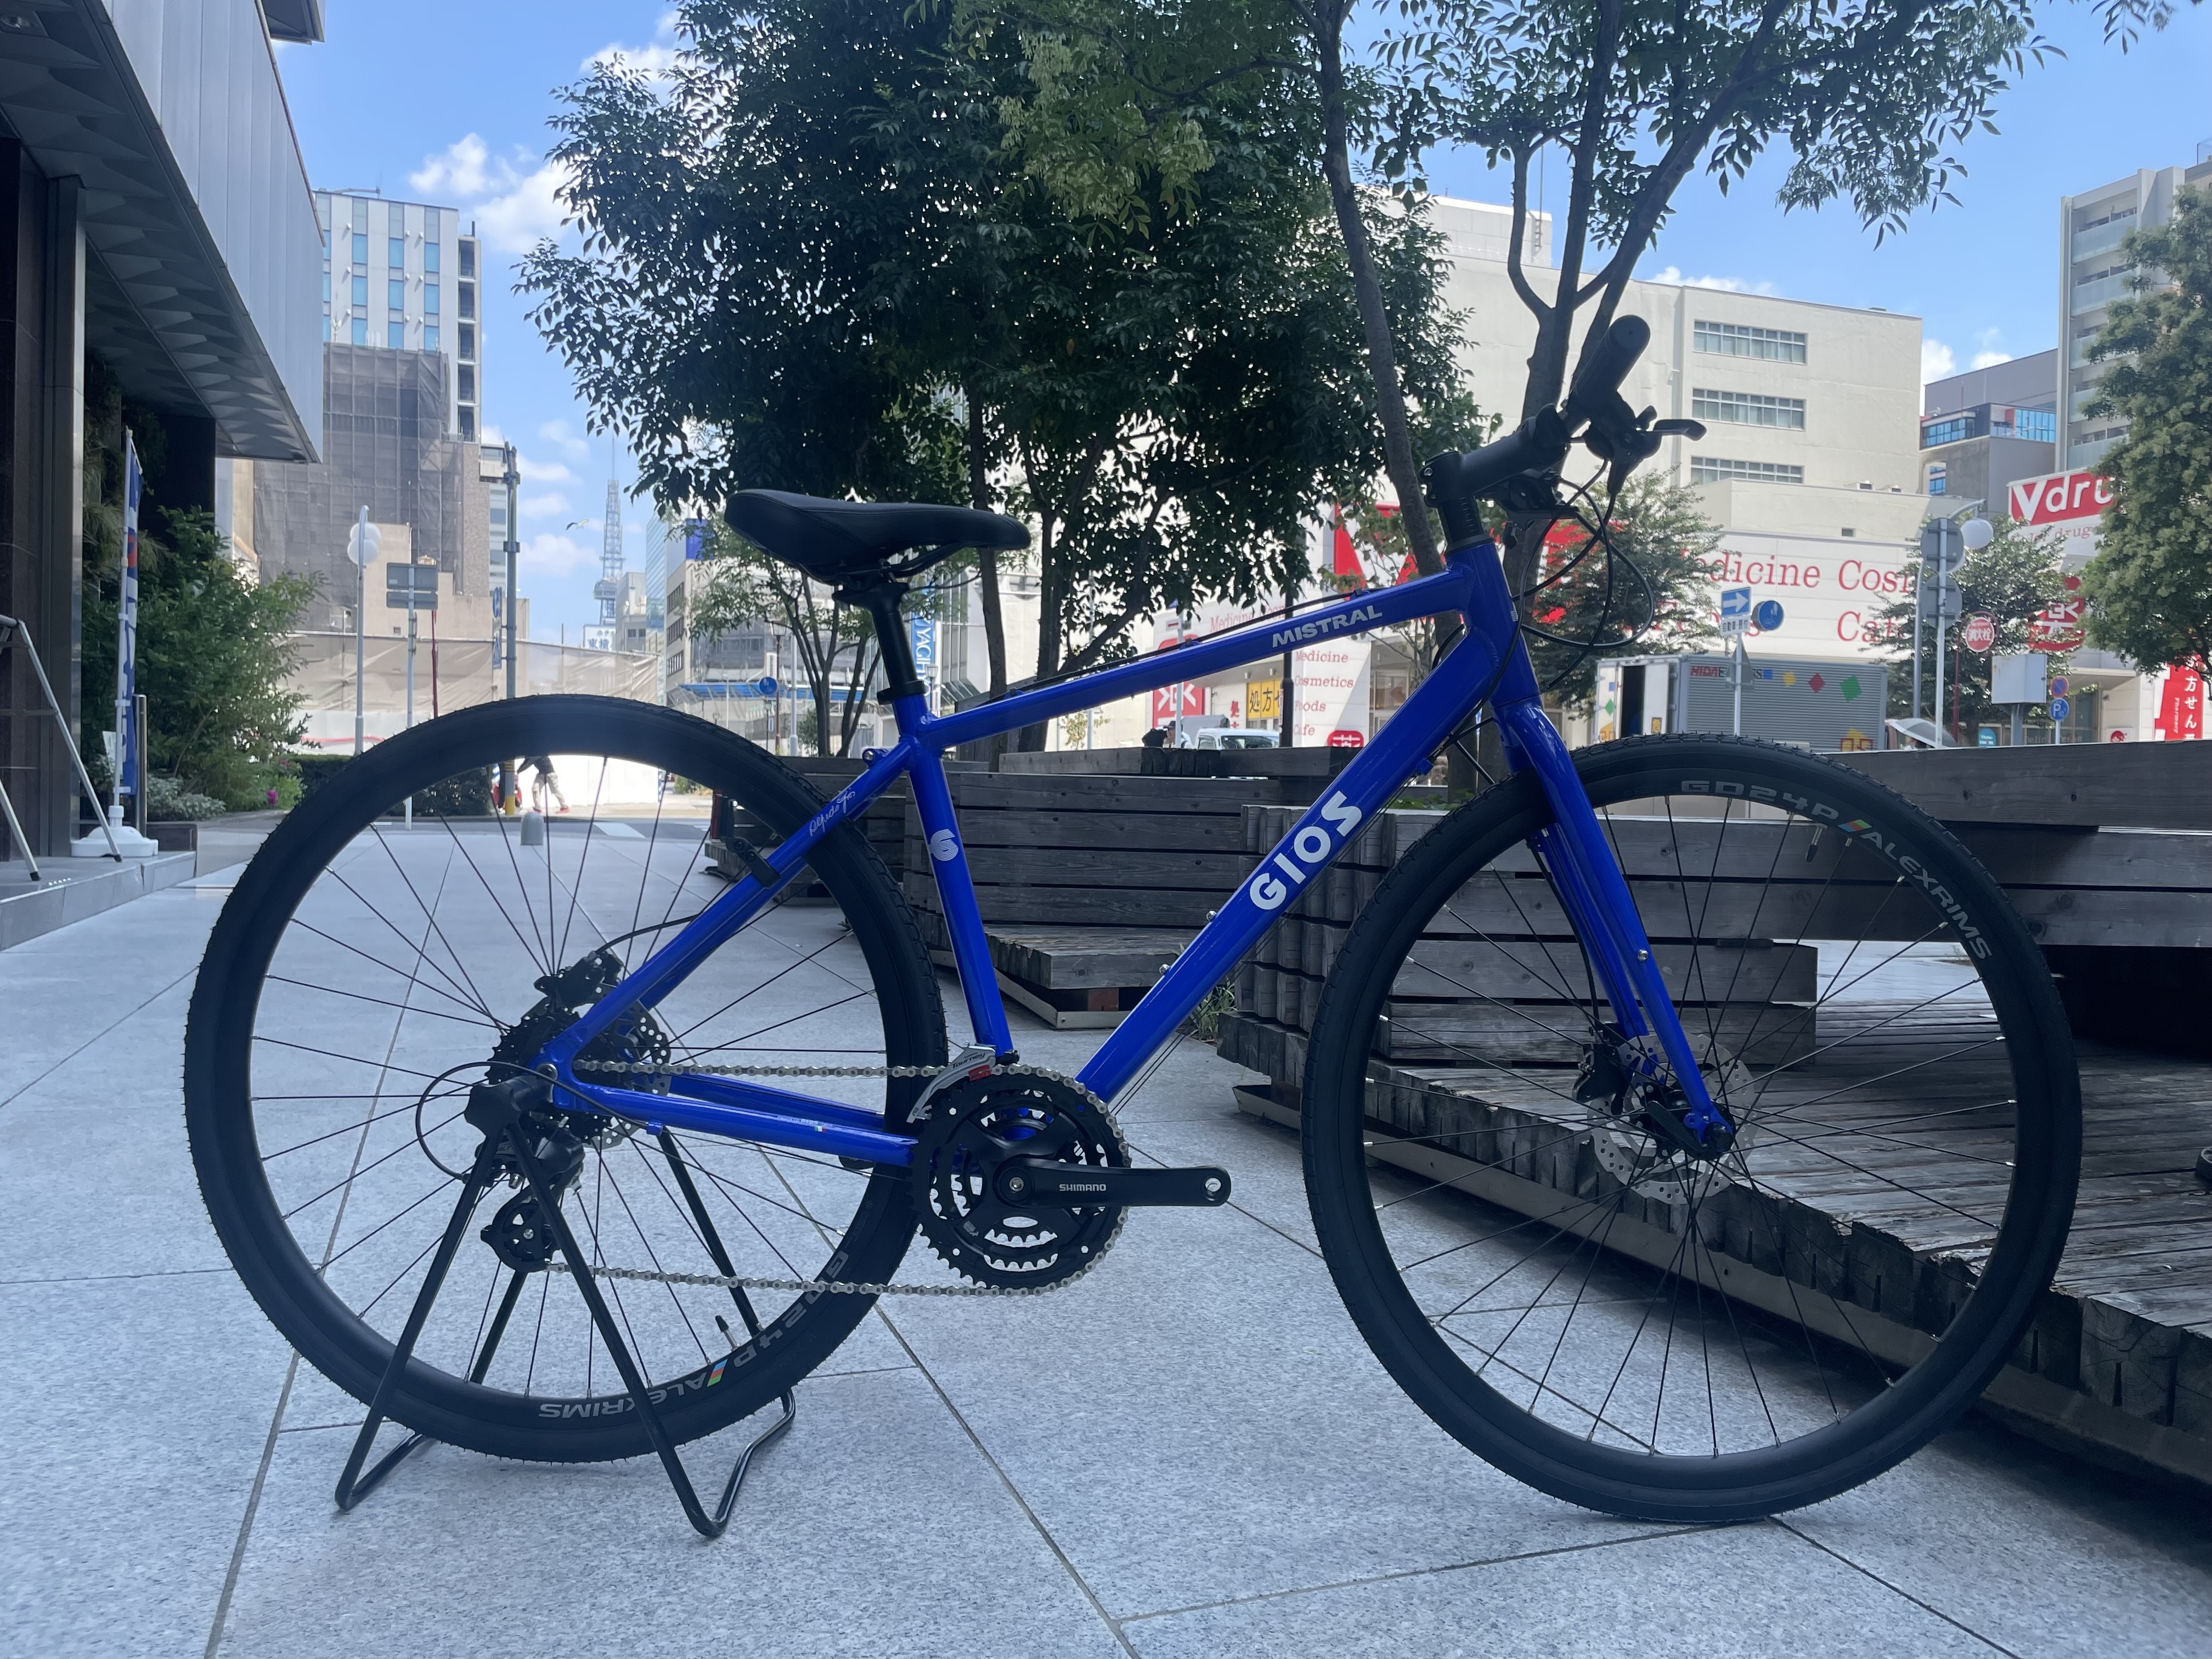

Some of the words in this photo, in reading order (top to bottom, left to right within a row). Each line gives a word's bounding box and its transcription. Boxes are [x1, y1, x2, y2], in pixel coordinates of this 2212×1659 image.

[2013, 474, 2114, 526] Vdru
[1681, 549, 1821, 588] dicine
[1272, 605, 1383, 648] MISTRAL
[1295, 650, 1348, 663] Medicine
[1295, 675, 1354, 688] Cosmetics
[1295, 700, 1326, 712] Foods
[1294, 724, 1315, 736] Cafe
[1249, 790, 1363, 910] GIOS
[1681, 780, 1839, 820] GD24P
[1860, 831, 1993, 960] ALEXRIMS
[952, 1053, 986, 1069] Tourney
[1059, 1183, 1107, 1192] SHIMANO
